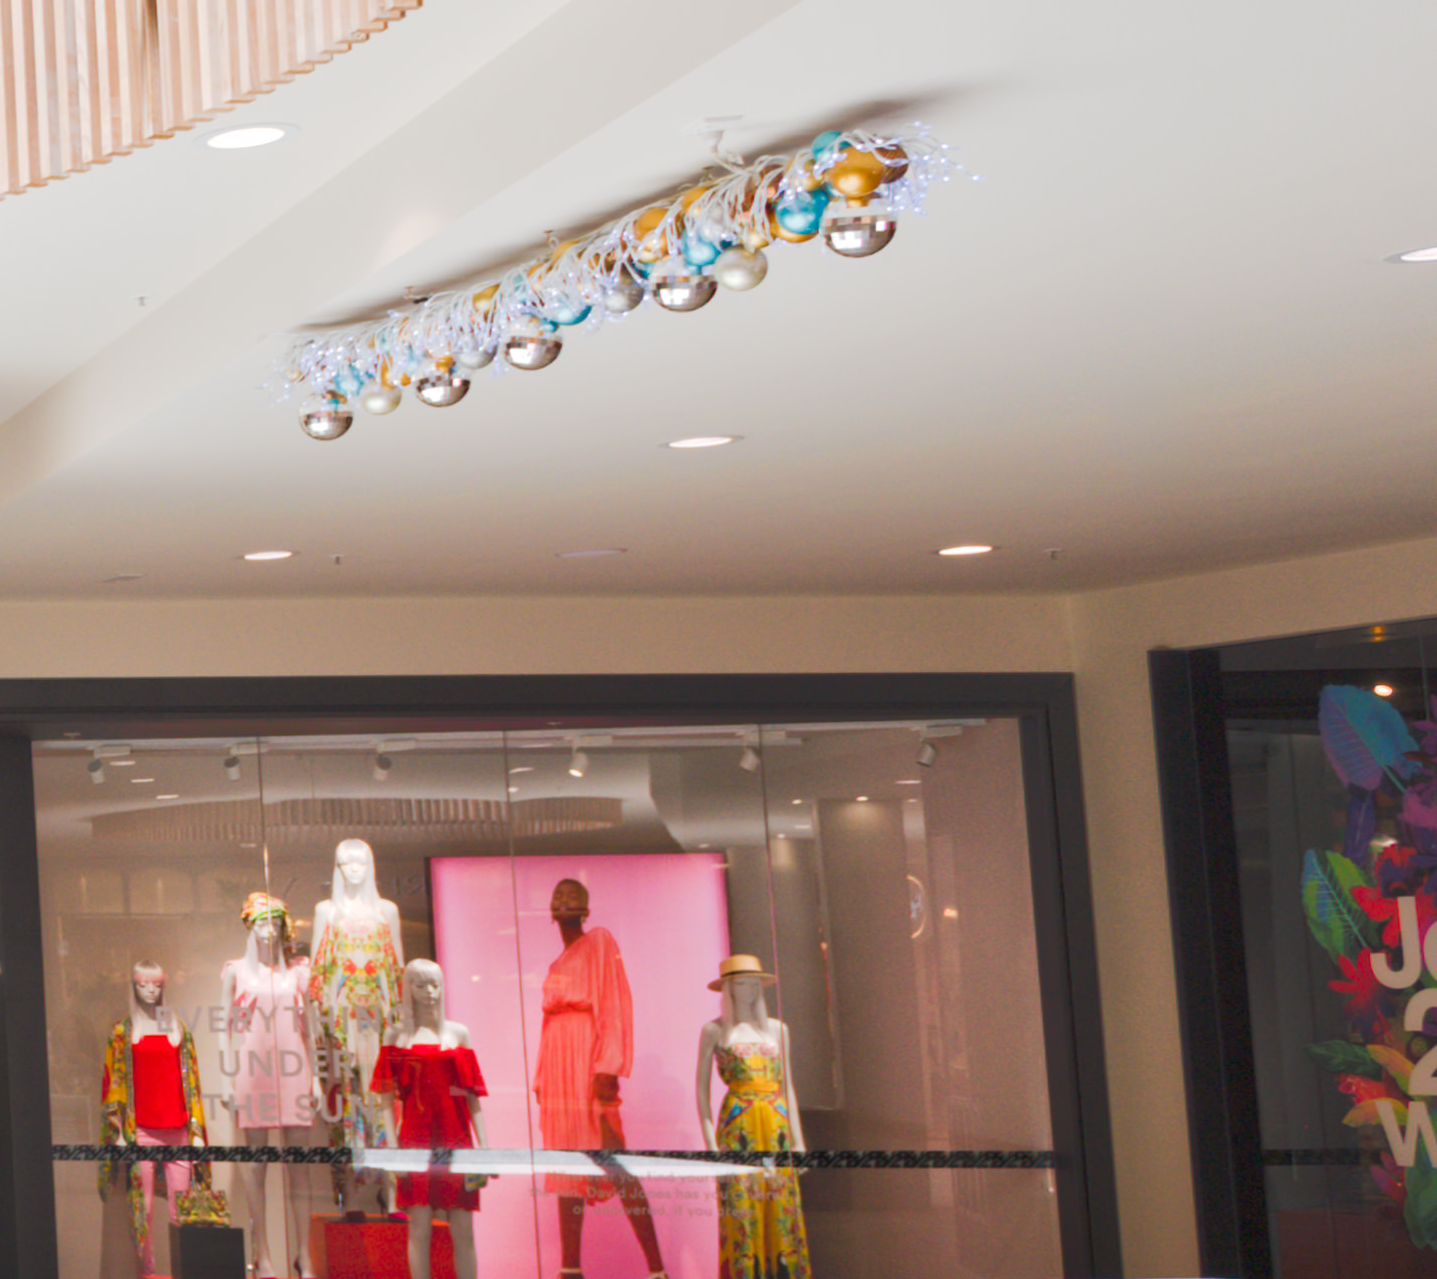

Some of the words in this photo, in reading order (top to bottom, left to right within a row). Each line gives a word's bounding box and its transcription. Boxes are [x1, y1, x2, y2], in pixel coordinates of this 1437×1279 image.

[155, 1005, 414, 1033] EVERYTHING
[219, 1050, 356, 1078] UNDER
[200, 1093, 282, 1121] THE
[294, 1093, 381, 1123] SUN
[1375, 1100, 1437, 1168] W
[587, 1187, 621, 1198] David
[630, 1188, 671, 1198] Jones
